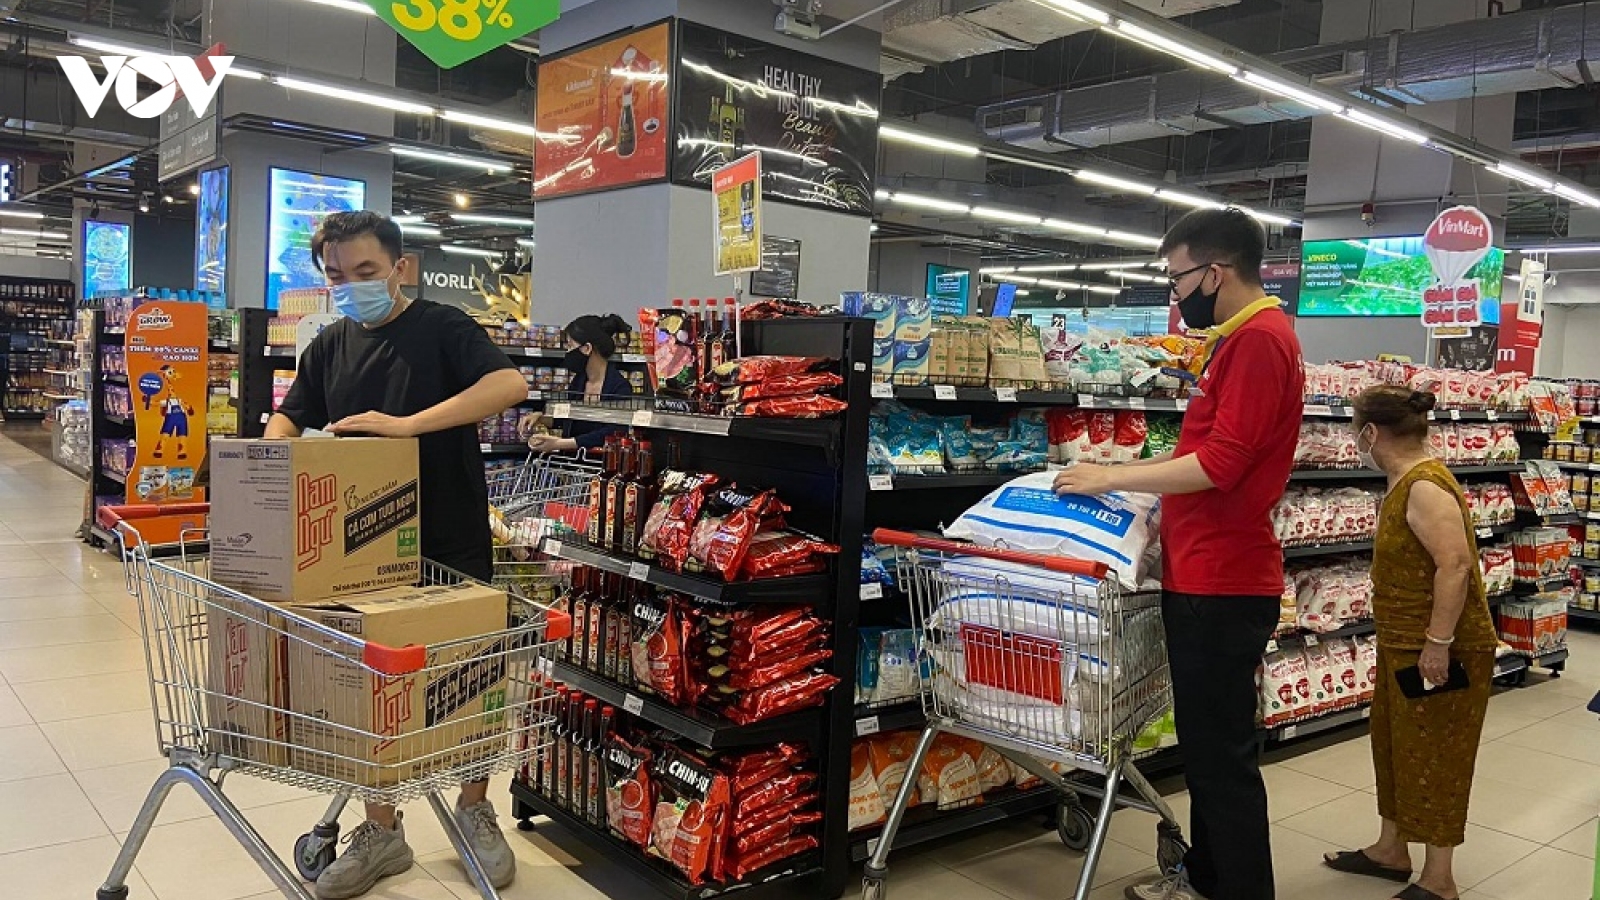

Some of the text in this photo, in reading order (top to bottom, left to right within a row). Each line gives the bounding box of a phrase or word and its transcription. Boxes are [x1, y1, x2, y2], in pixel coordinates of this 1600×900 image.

[764, 65, 822, 98] HEALTHY
[1438, 217, 1486, 238] VinMart
[668, 760, 710, 793] CHIN-SU
